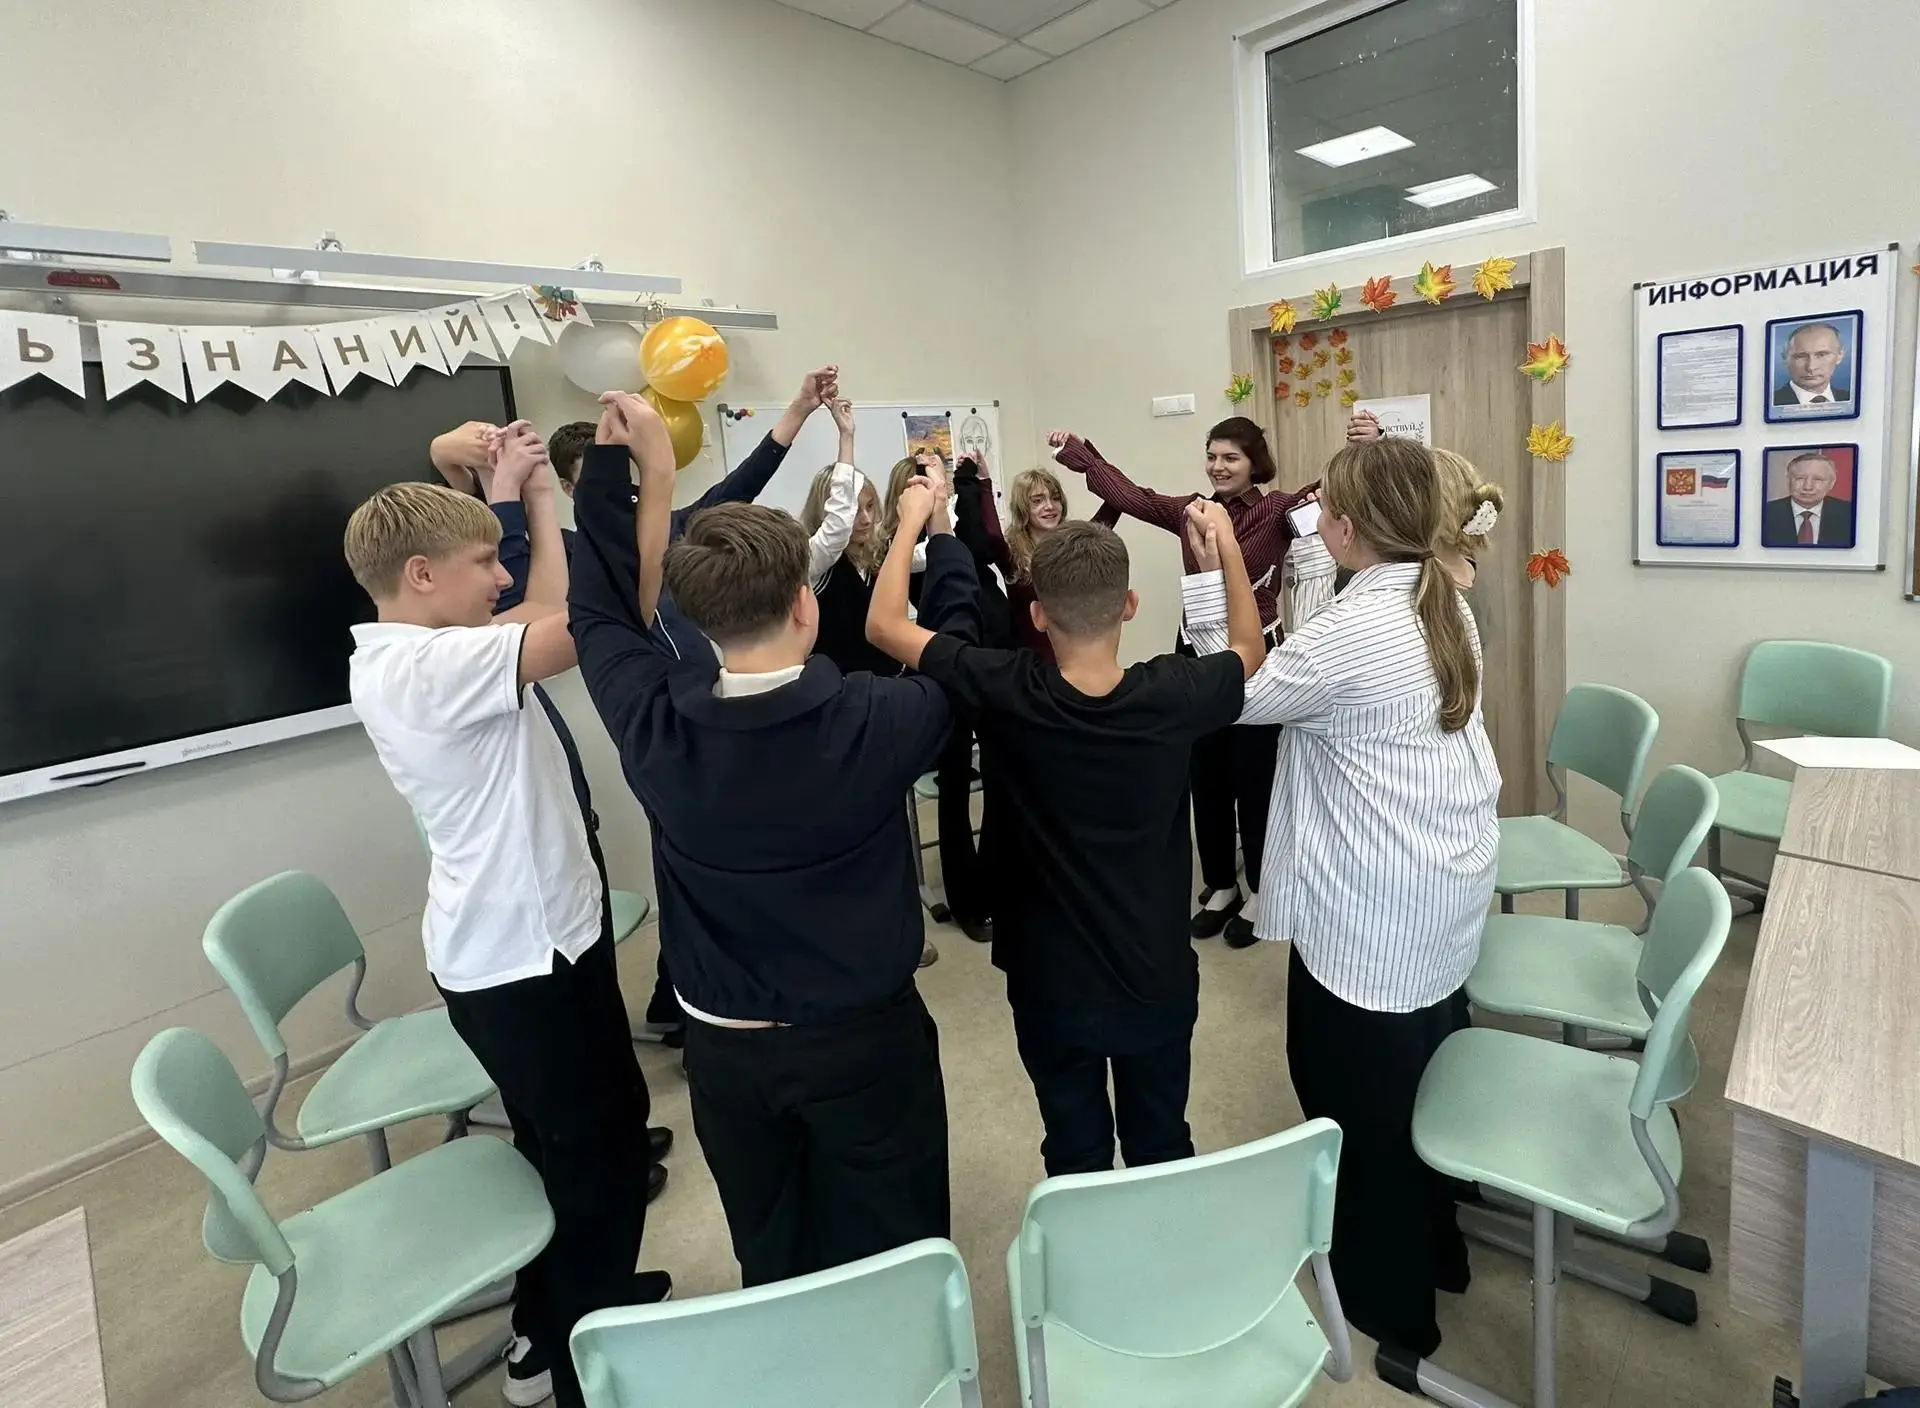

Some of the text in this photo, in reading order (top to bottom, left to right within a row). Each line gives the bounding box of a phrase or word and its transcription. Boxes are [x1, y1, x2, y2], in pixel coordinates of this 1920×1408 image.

[1648, 253, 1879, 307] ИНФОРМАЦИЯ
[126, 303, 521, 372] ЗНАНИЙ!
[1385, 422, 1416, 434] ВСТВУЙ
